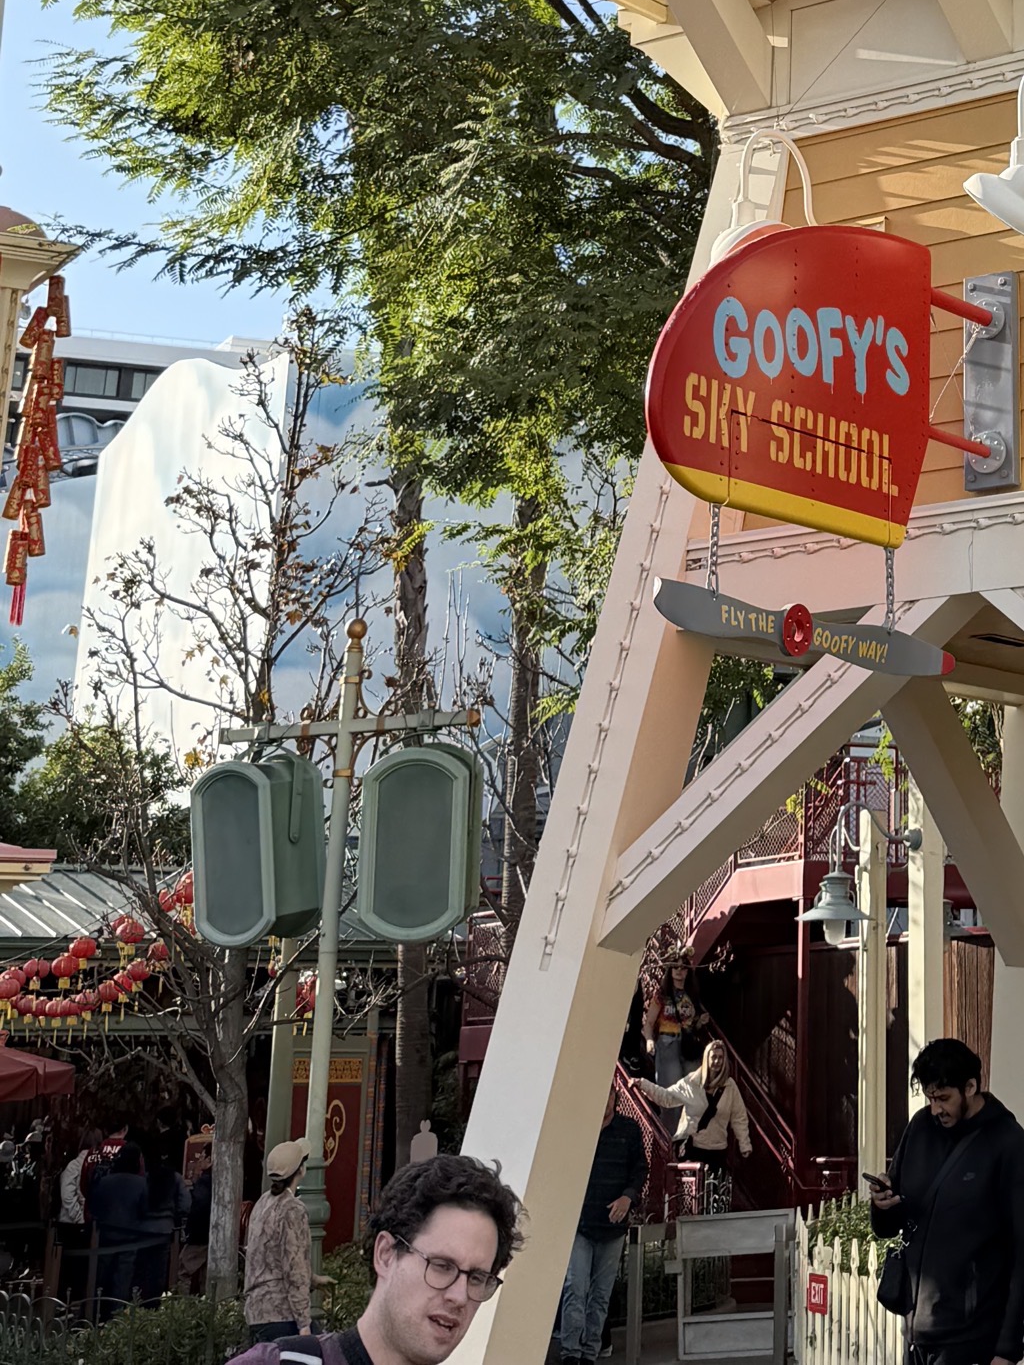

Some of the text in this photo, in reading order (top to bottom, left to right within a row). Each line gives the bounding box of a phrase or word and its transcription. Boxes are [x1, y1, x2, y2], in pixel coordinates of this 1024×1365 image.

[713, 296, 910, 399] GOOFY'S
[683, 372, 899, 497] SKY SCHOOL
[721, 604, 888, 664] FLY THE GOOFY WAY!
[811, 1281, 824, 1305] EXIT
